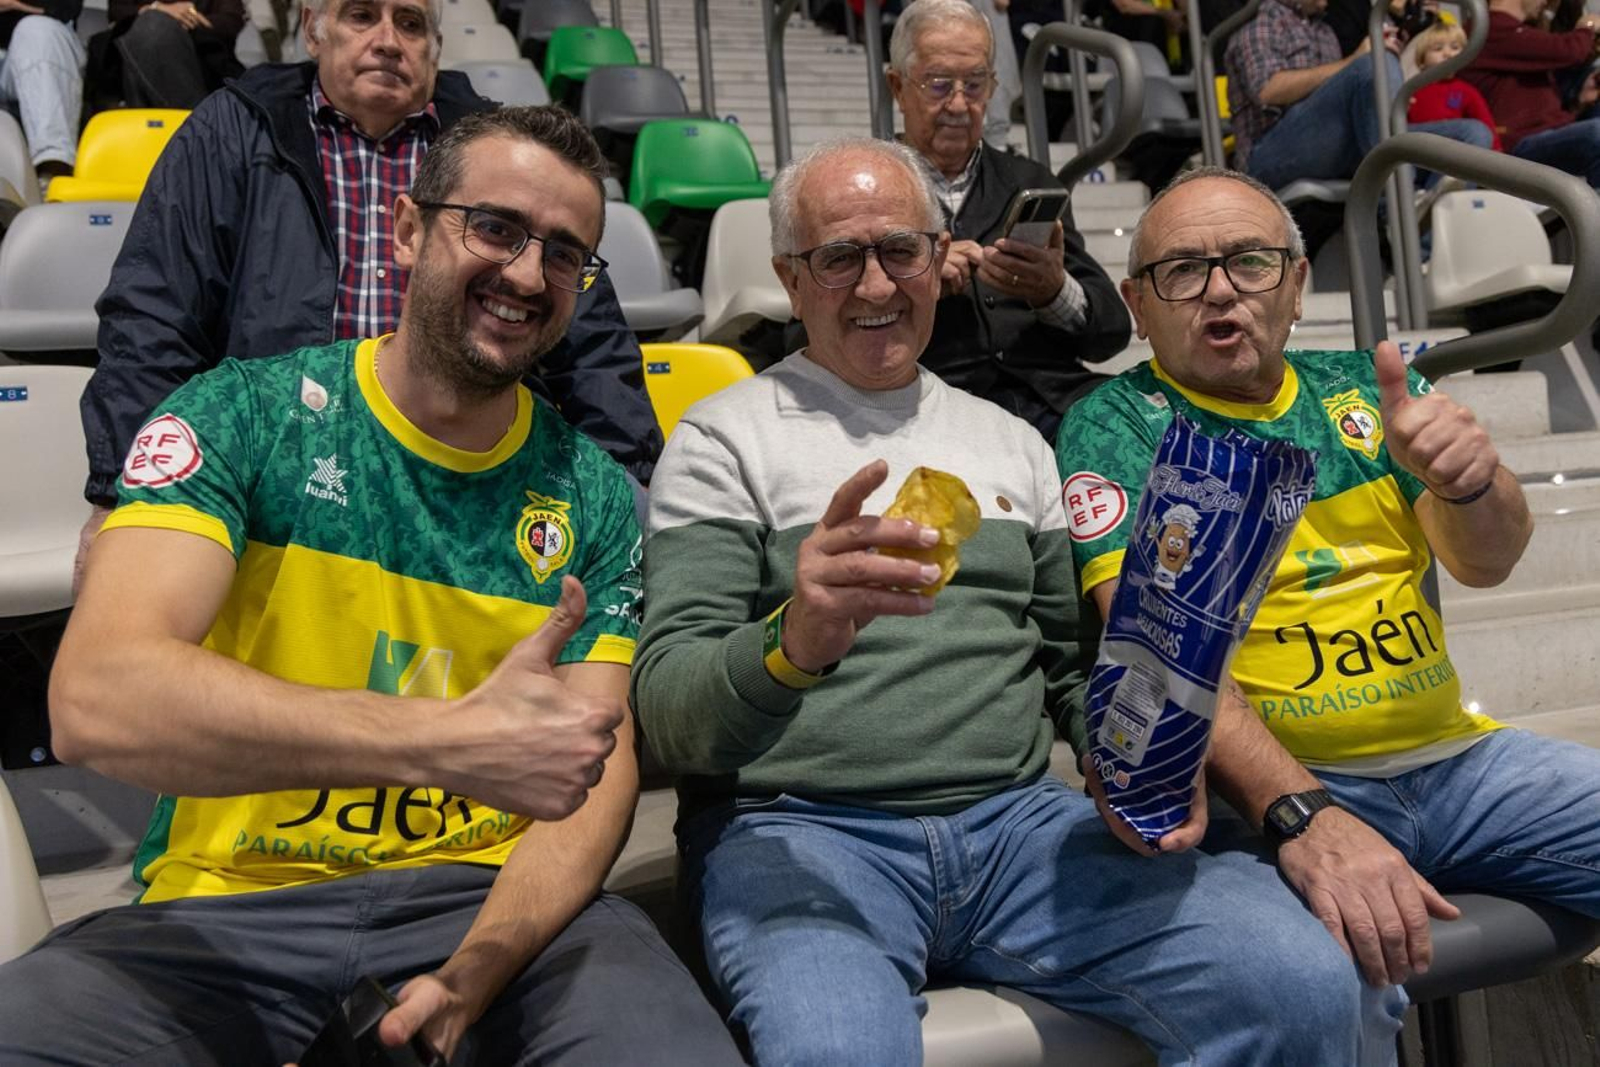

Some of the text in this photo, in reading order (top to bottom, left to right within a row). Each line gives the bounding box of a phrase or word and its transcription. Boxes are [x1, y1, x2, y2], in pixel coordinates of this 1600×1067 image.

[7, 389, 17, 400] 8
[1336, 404, 1361, 419] JAEN
[532, 512, 562, 526] JAEN
[1274, 599, 1438, 691] Jaén
[1260, 683, 1382, 721] PARAÍSO
